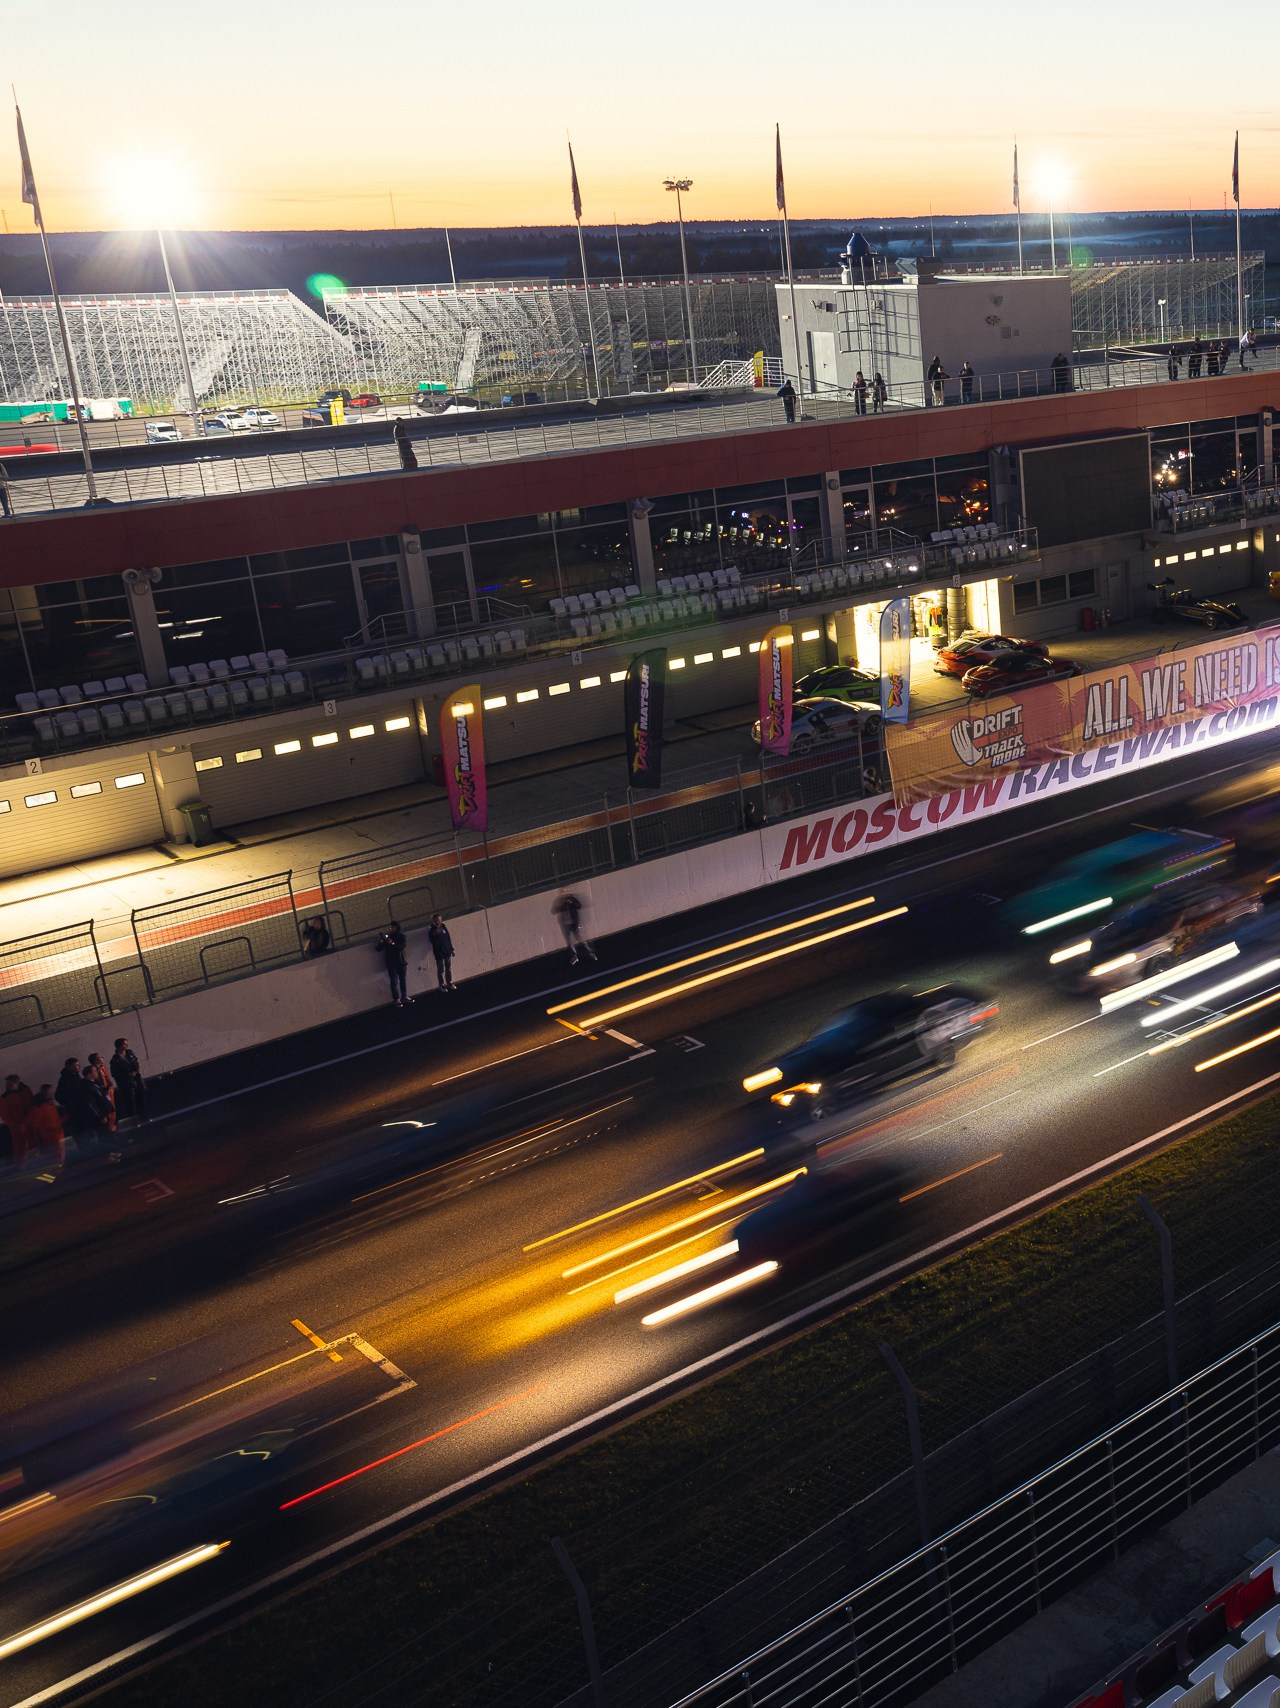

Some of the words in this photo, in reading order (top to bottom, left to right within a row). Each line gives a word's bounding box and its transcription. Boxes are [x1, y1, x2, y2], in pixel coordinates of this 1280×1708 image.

[639, 664, 649, 730] MATSURI
[1083, 675, 1133, 741] ALL
[1142, 660, 1187, 721] WE
[1194, 642, 1258, 708] NEED
[455, 702, 471, 772] MATSU
[973, 704, 1023, 739] DRIFT
[998, 726, 1018, 738] EXPO
[30, 761, 39, 774] 2
